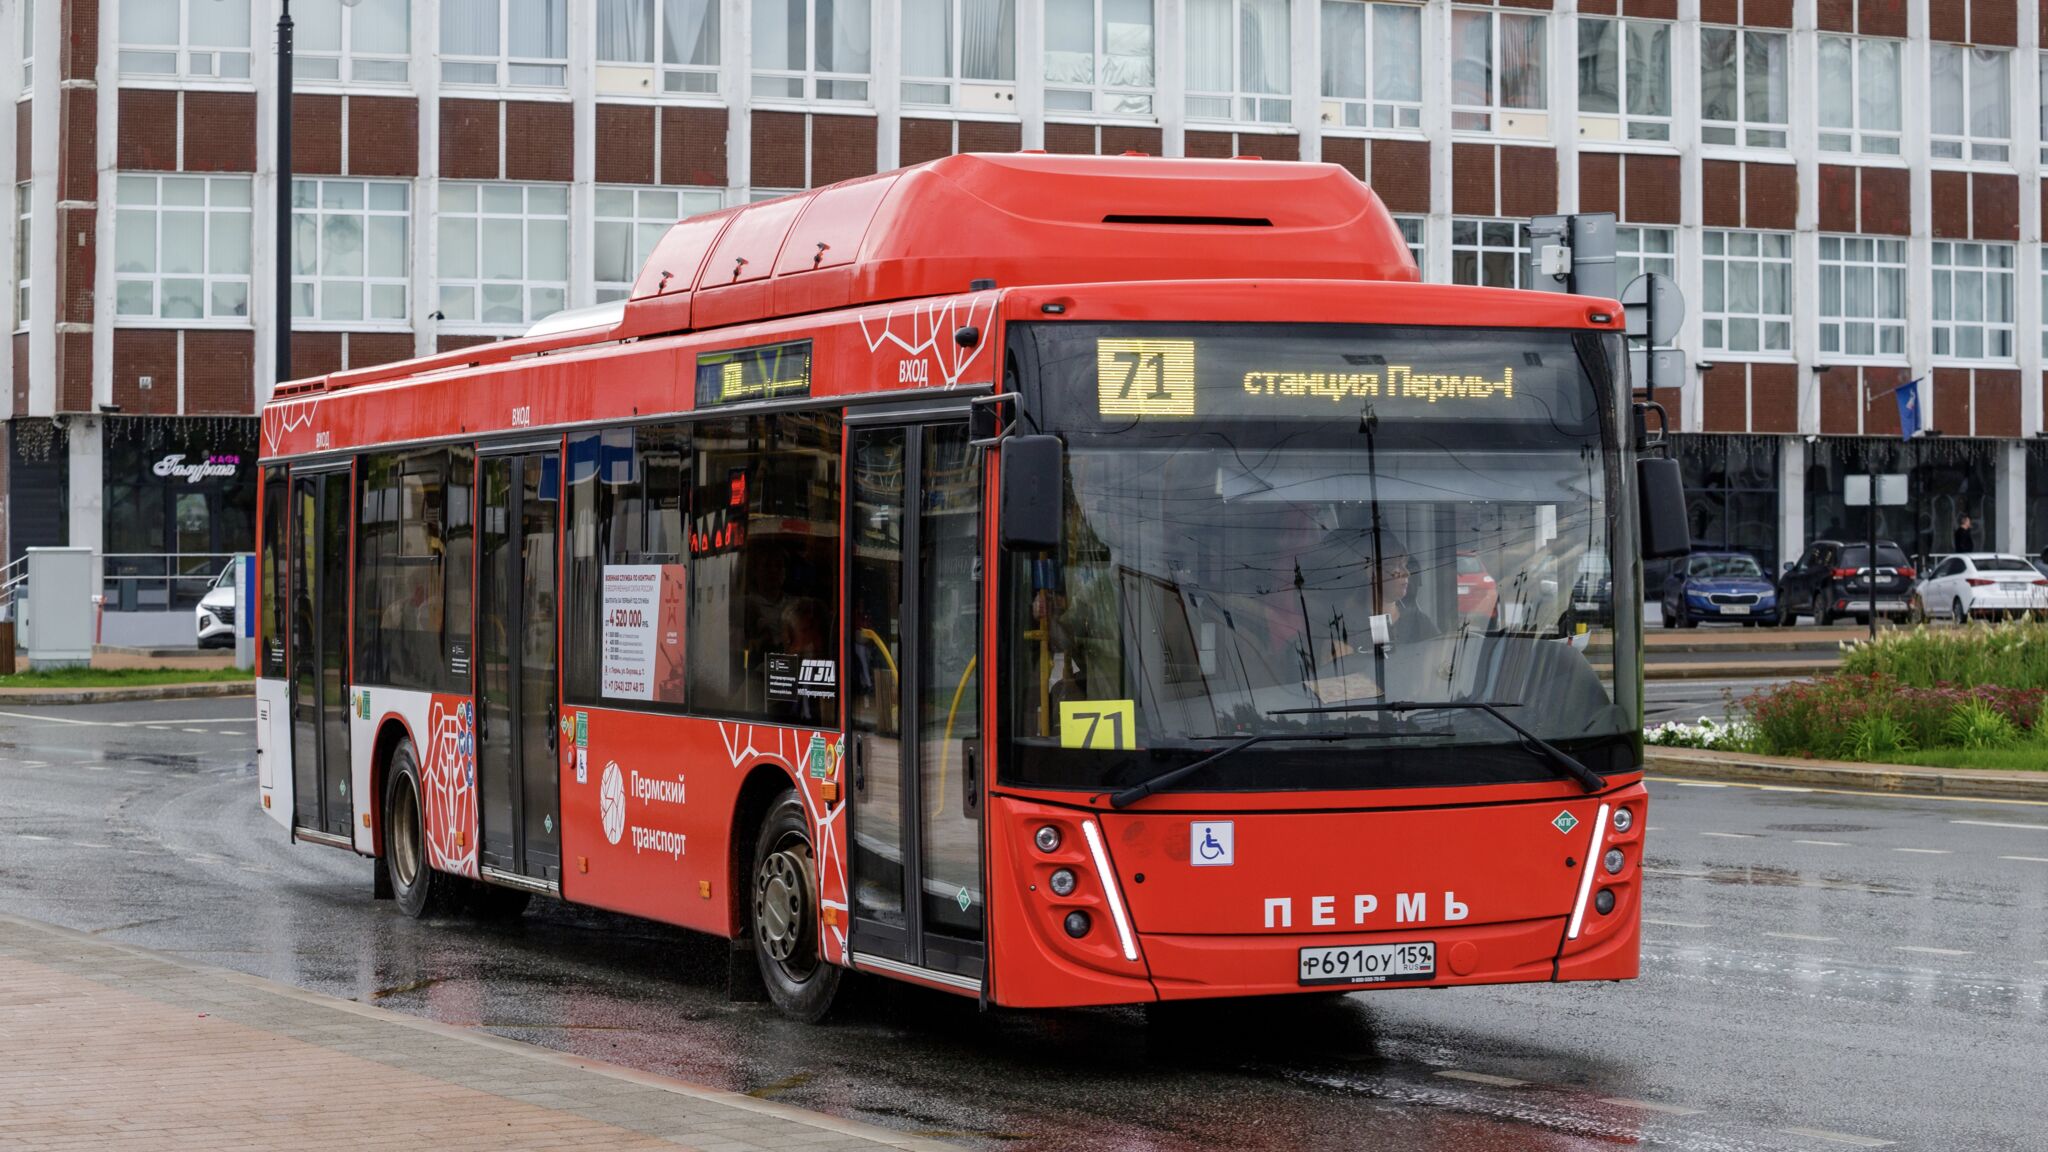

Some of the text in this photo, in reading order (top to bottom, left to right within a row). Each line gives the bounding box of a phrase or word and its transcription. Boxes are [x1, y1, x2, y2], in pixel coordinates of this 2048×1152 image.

[899, 358, 929, 388] ВХОД
[1115, 352, 1172, 399] 71
[1244, 372, 1378, 401] станция
[511, 405, 530, 428] ВХОД
[316, 430, 330, 449] ВХОД
[209, 455, 240, 464] КАФЕ
[609, 609, 615, 627] 4
[616, 609, 628, 627] 520
[629, 609, 642, 627] 000
[1073, 711, 1123, 749] 71
[631, 770, 685, 806] Пермский
[631, 826, 686, 861] транспорт
[1264, 891, 1469, 928] ПЕРМЬ
[1308, 946, 1428, 975] Р691ОУ 159
